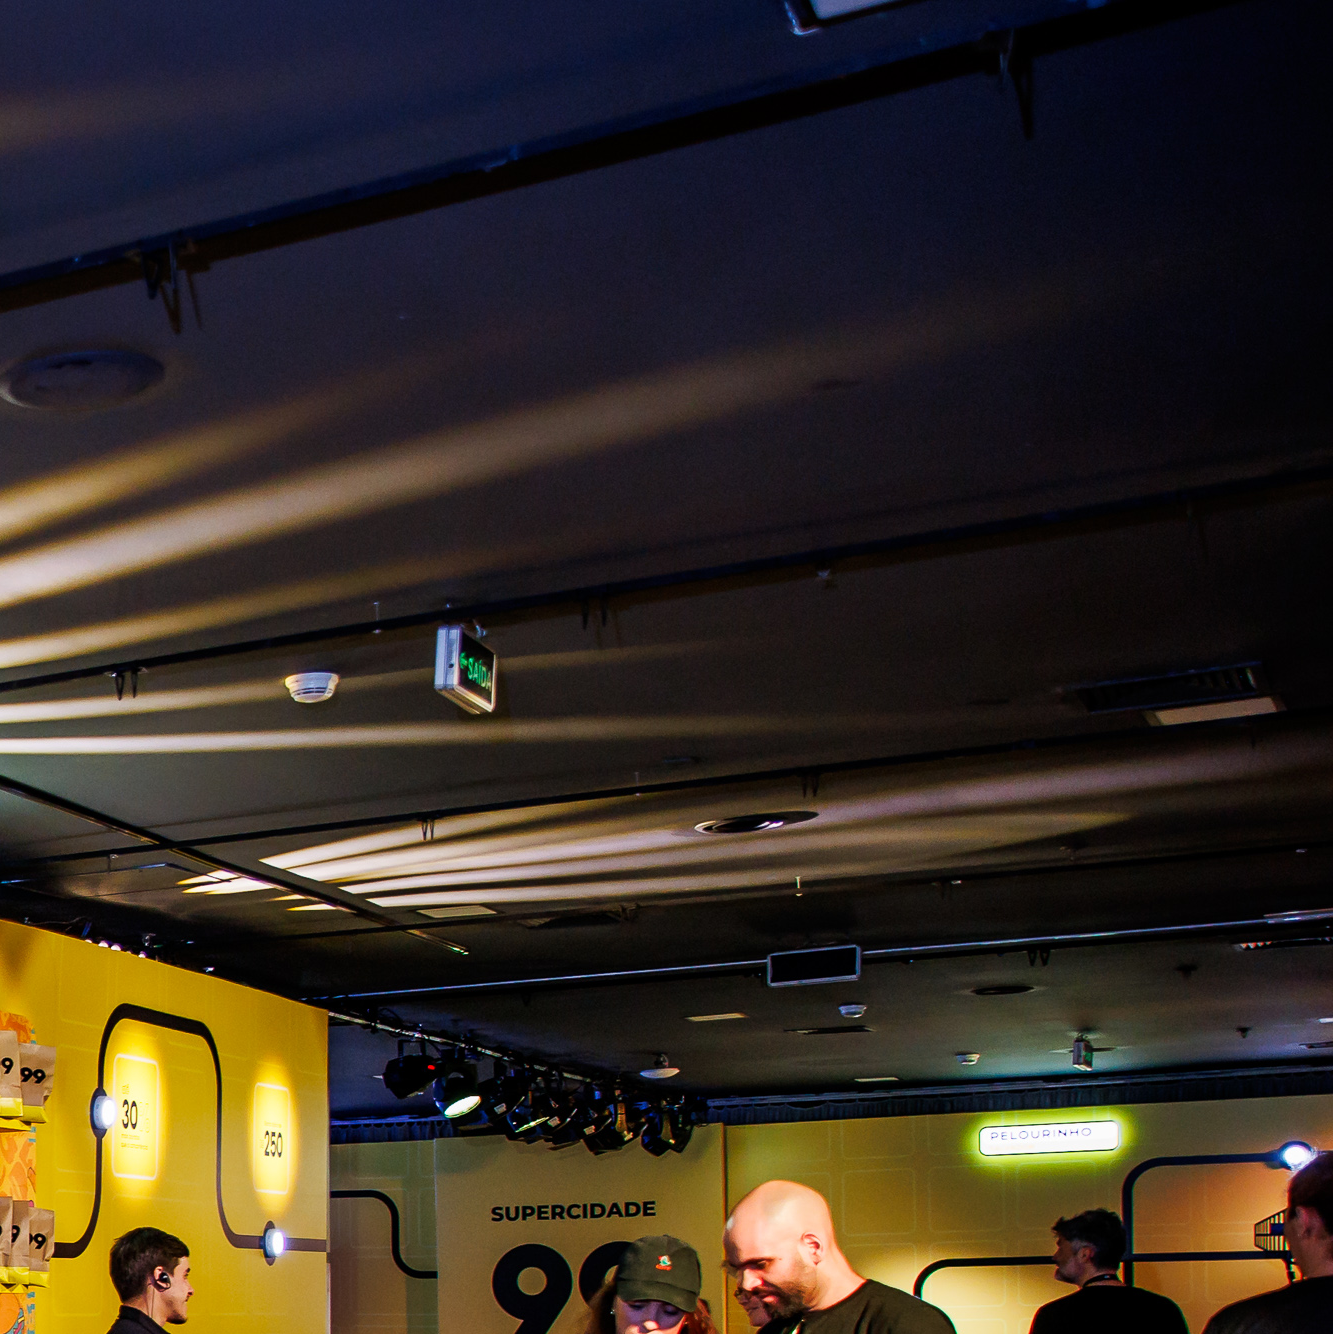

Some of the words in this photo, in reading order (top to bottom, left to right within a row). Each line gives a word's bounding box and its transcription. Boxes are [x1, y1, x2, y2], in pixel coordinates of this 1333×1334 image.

[0, 1057, 14, 1074] 9
[20, 1067, 46, 1084] 99
[990, 1128, 1092, 1141] PELOURINHO
[264, 1130, 283, 1158] 250
[491, 1201, 656, 1222] SUPERCIDADE
